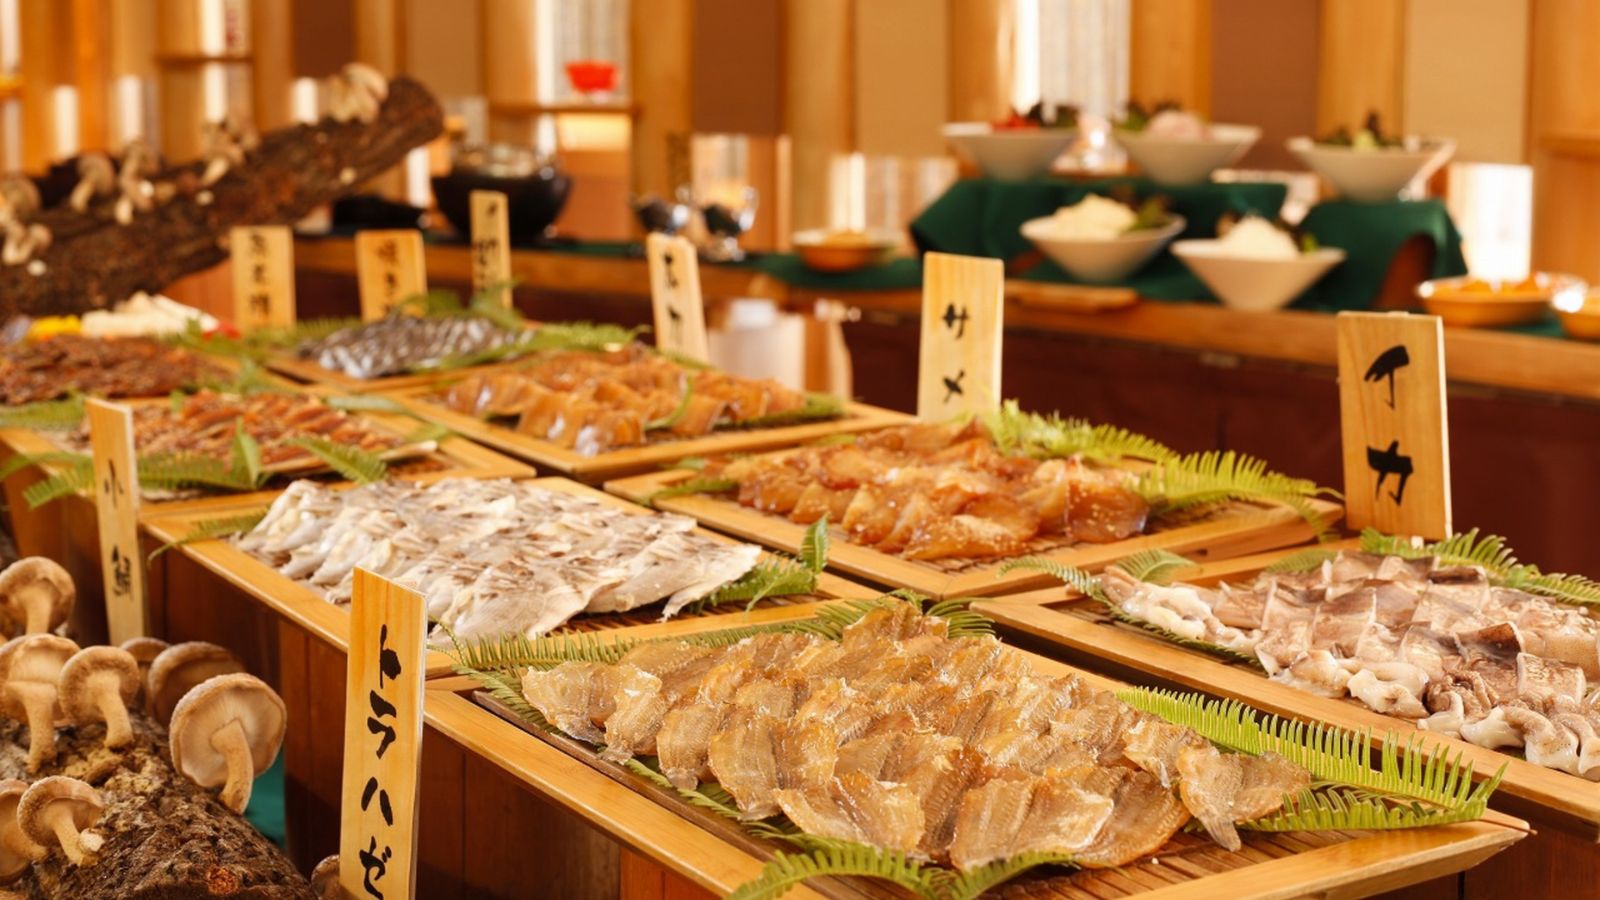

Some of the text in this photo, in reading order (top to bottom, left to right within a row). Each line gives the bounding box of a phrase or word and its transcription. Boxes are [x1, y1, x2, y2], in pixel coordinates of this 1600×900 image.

[942, 303, 969, 404] サメ
[1364, 345, 1413, 506] イカ
[359, 624, 401, 900] トラハゼ
